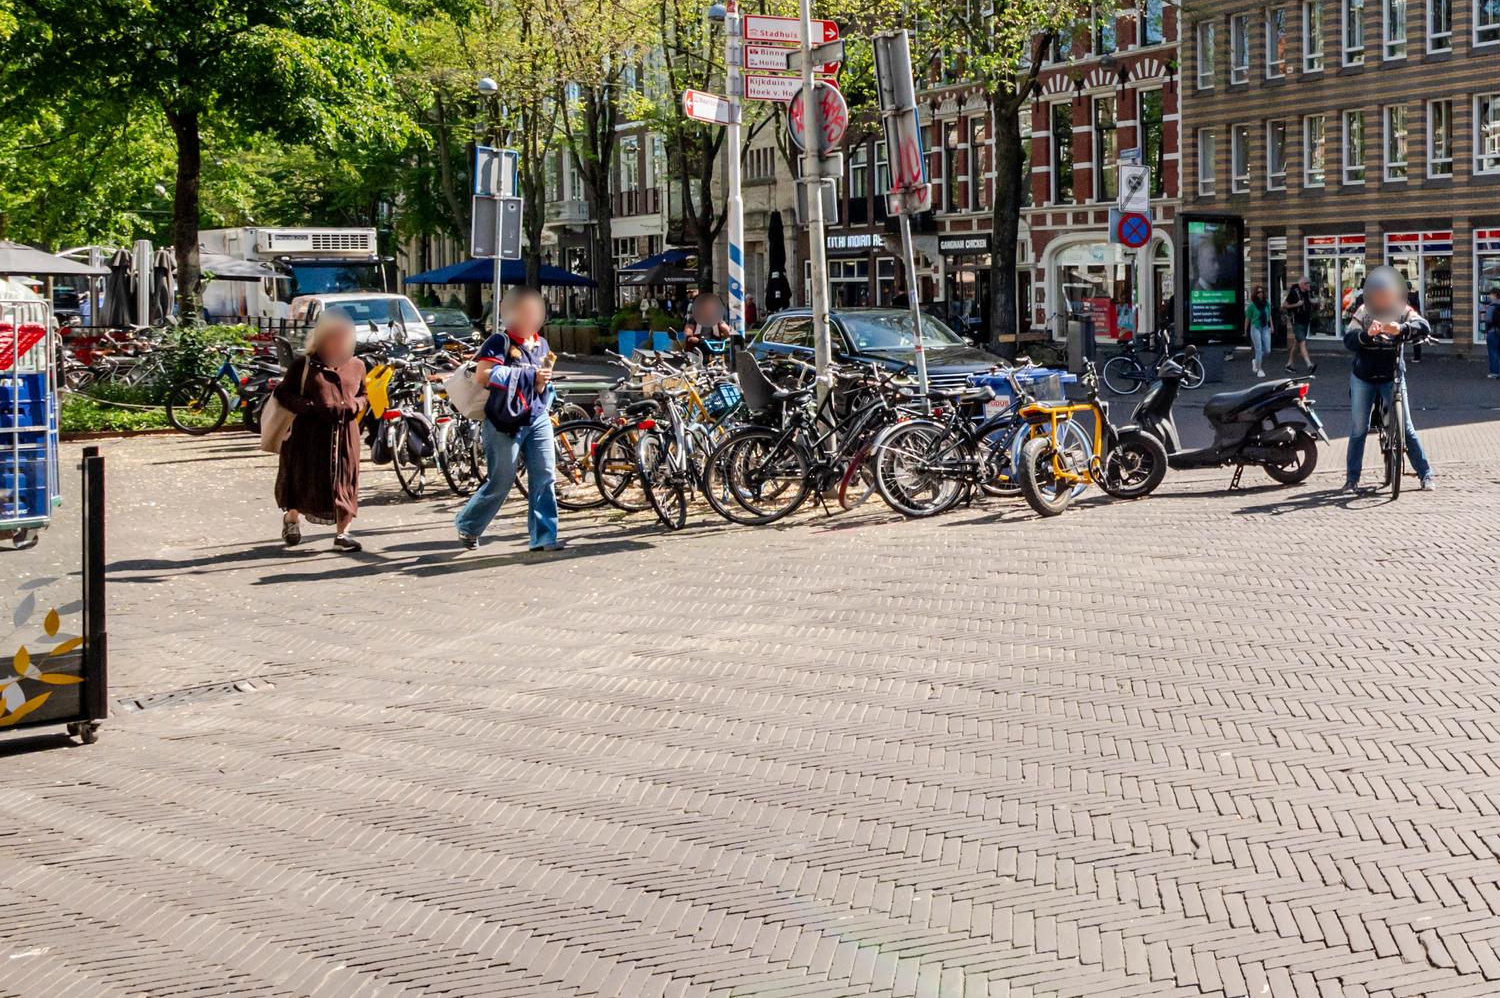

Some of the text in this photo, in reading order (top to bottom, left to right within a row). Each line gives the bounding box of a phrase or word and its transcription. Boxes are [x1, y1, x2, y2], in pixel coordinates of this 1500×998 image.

[760, 29, 798, 38] Stadhuis
[760, 49, 785, 57] Binne
[749, 77, 786, 87] Kijkduin
[749, 88, 772, 97] Hoek
[782, 89, 795, 97] Ho
[847, 234, 871, 248] INDIAN
[965, 238, 987, 249] CHICKEN
